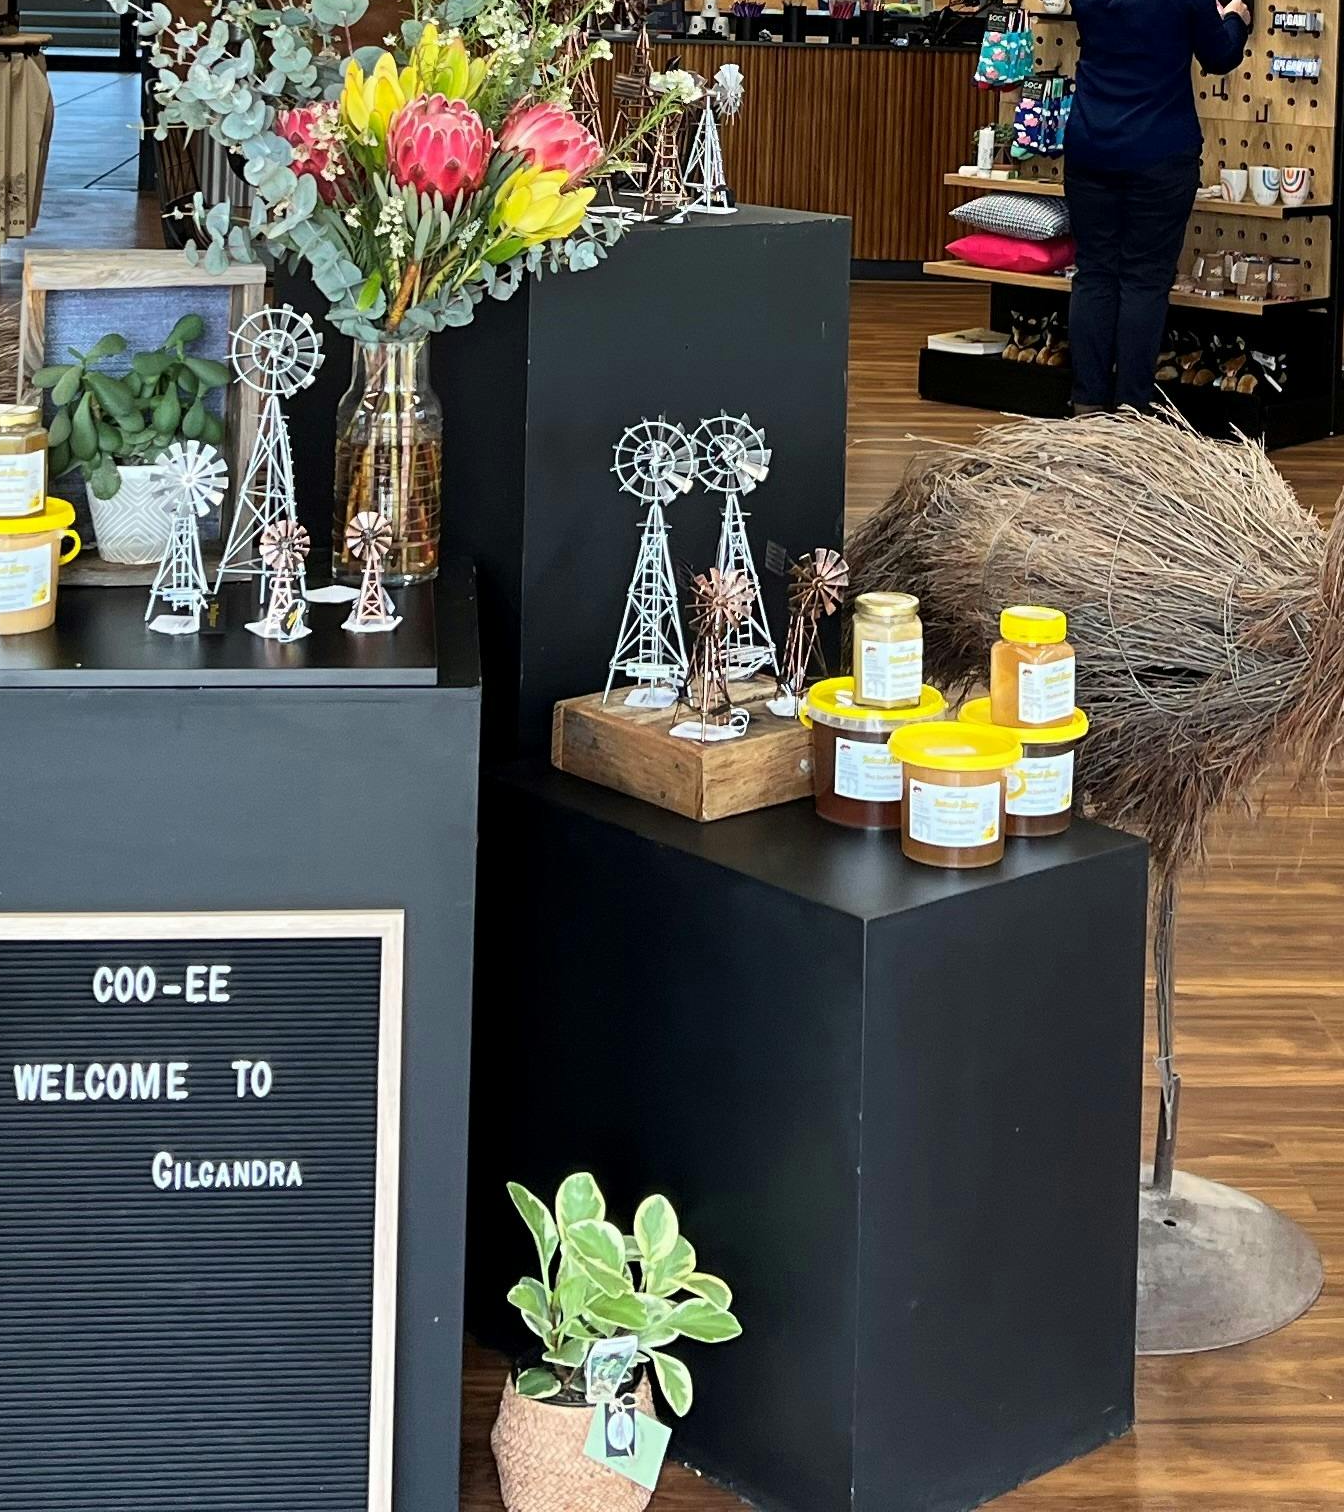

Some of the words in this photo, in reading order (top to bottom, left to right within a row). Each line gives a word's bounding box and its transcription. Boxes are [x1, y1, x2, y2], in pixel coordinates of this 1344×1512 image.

[989, 14, 1007, 22] SOCK
[1024, 81, 1042, 89] SOCK
[92, 966, 232, 1003] COO-EE
[13, 1062, 189, 1101] WELCOME
[231, 1061, 272, 1097] TO
[152, 1151, 303, 1190] GILGANDRA
